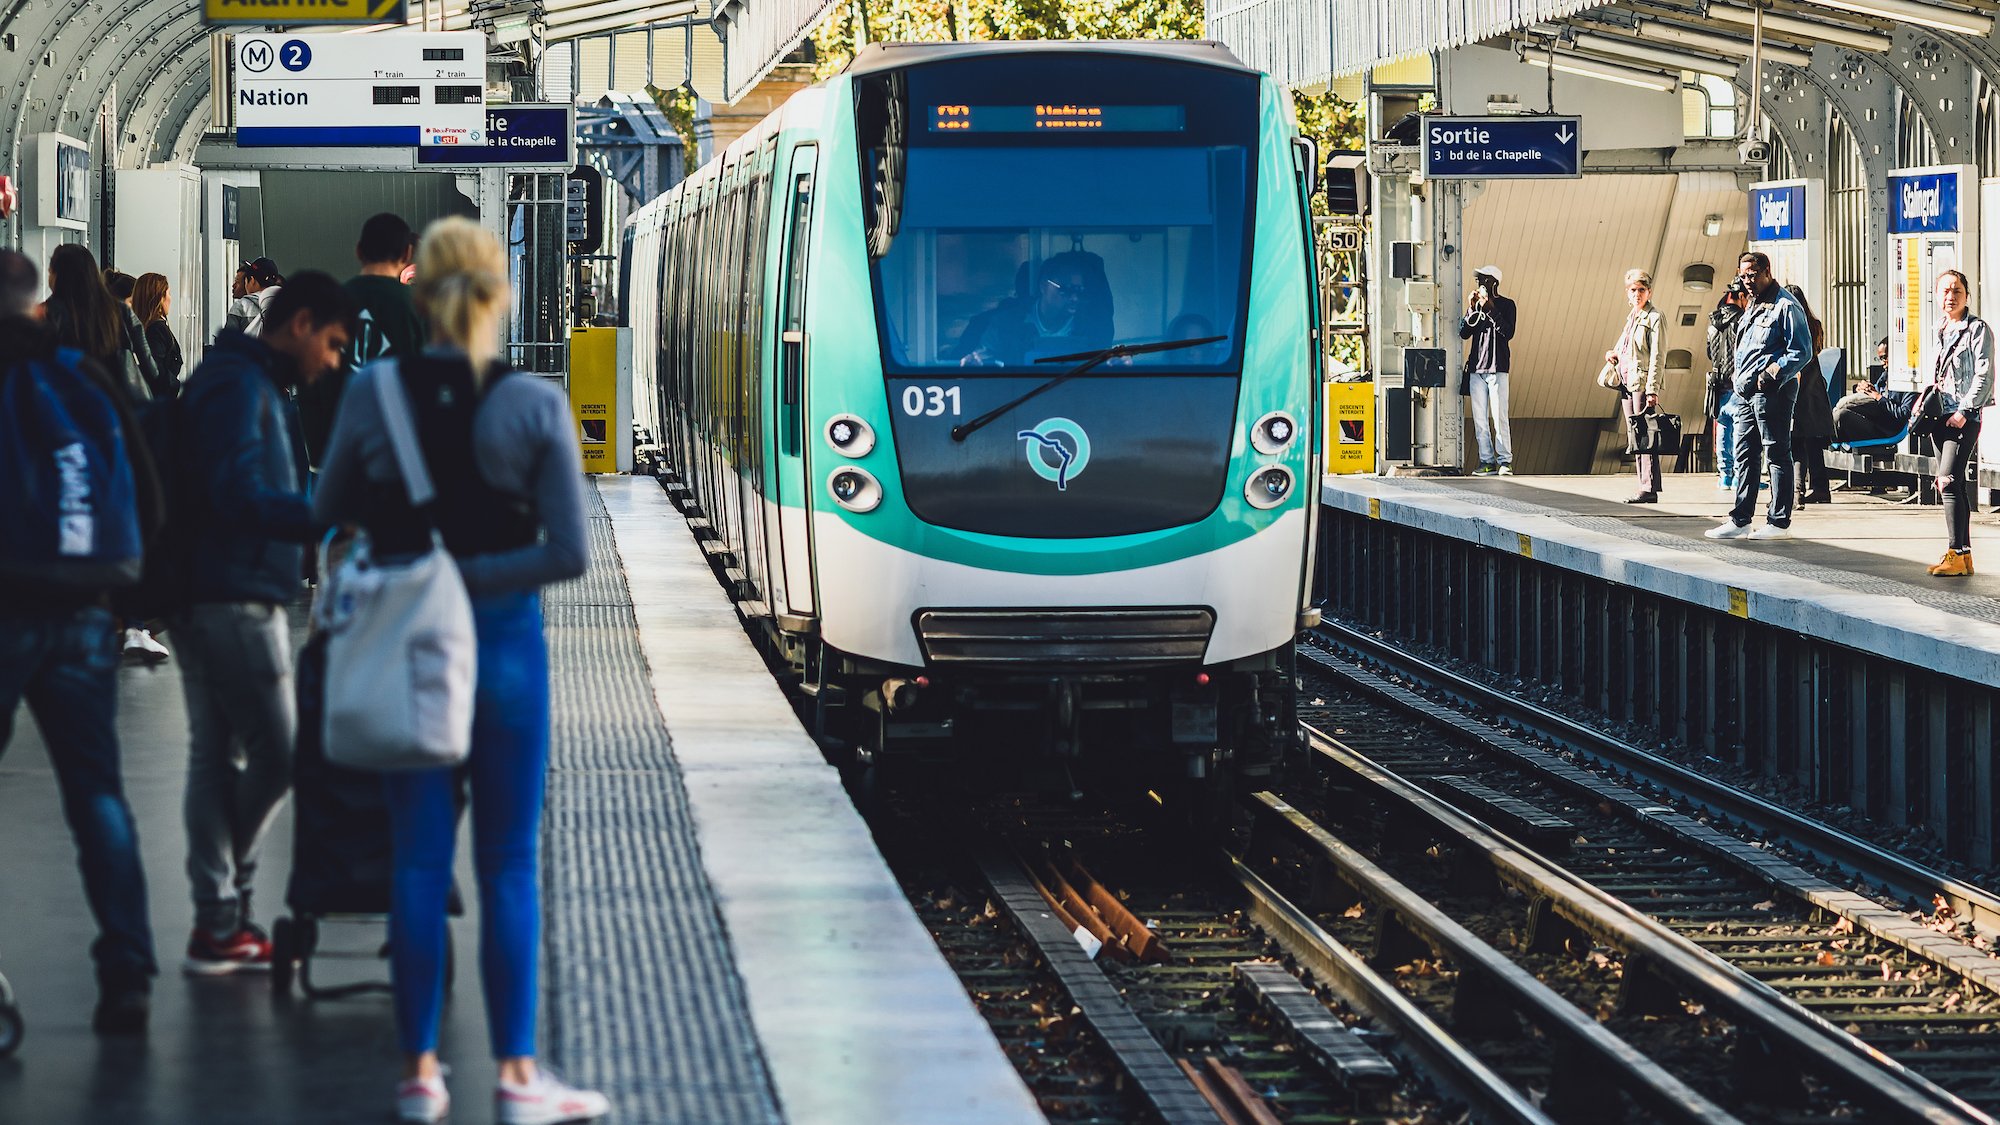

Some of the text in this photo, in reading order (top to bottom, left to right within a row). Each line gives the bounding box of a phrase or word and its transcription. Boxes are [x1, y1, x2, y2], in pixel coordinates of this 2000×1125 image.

[288, 45, 303, 66] 2
[385, 70, 404, 78] train
[240, 88, 308, 106] Nation
[402, 95, 419, 104] min
[464, 94, 481, 103] min
[498, 136, 508, 146] la
[510, 136, 557, 148] Chapelle
[1431, 126, 1490, 144] Sortie
[1434, 149, 1542, 162] 3 bd de la Chapelle
[1903, 178, 1940, 227] Stalingrad
[1759, 192, 1790, 236] Stalingrad
[1332, 232, 1356, 249] 50
[902, 385, 961, 417] 031
